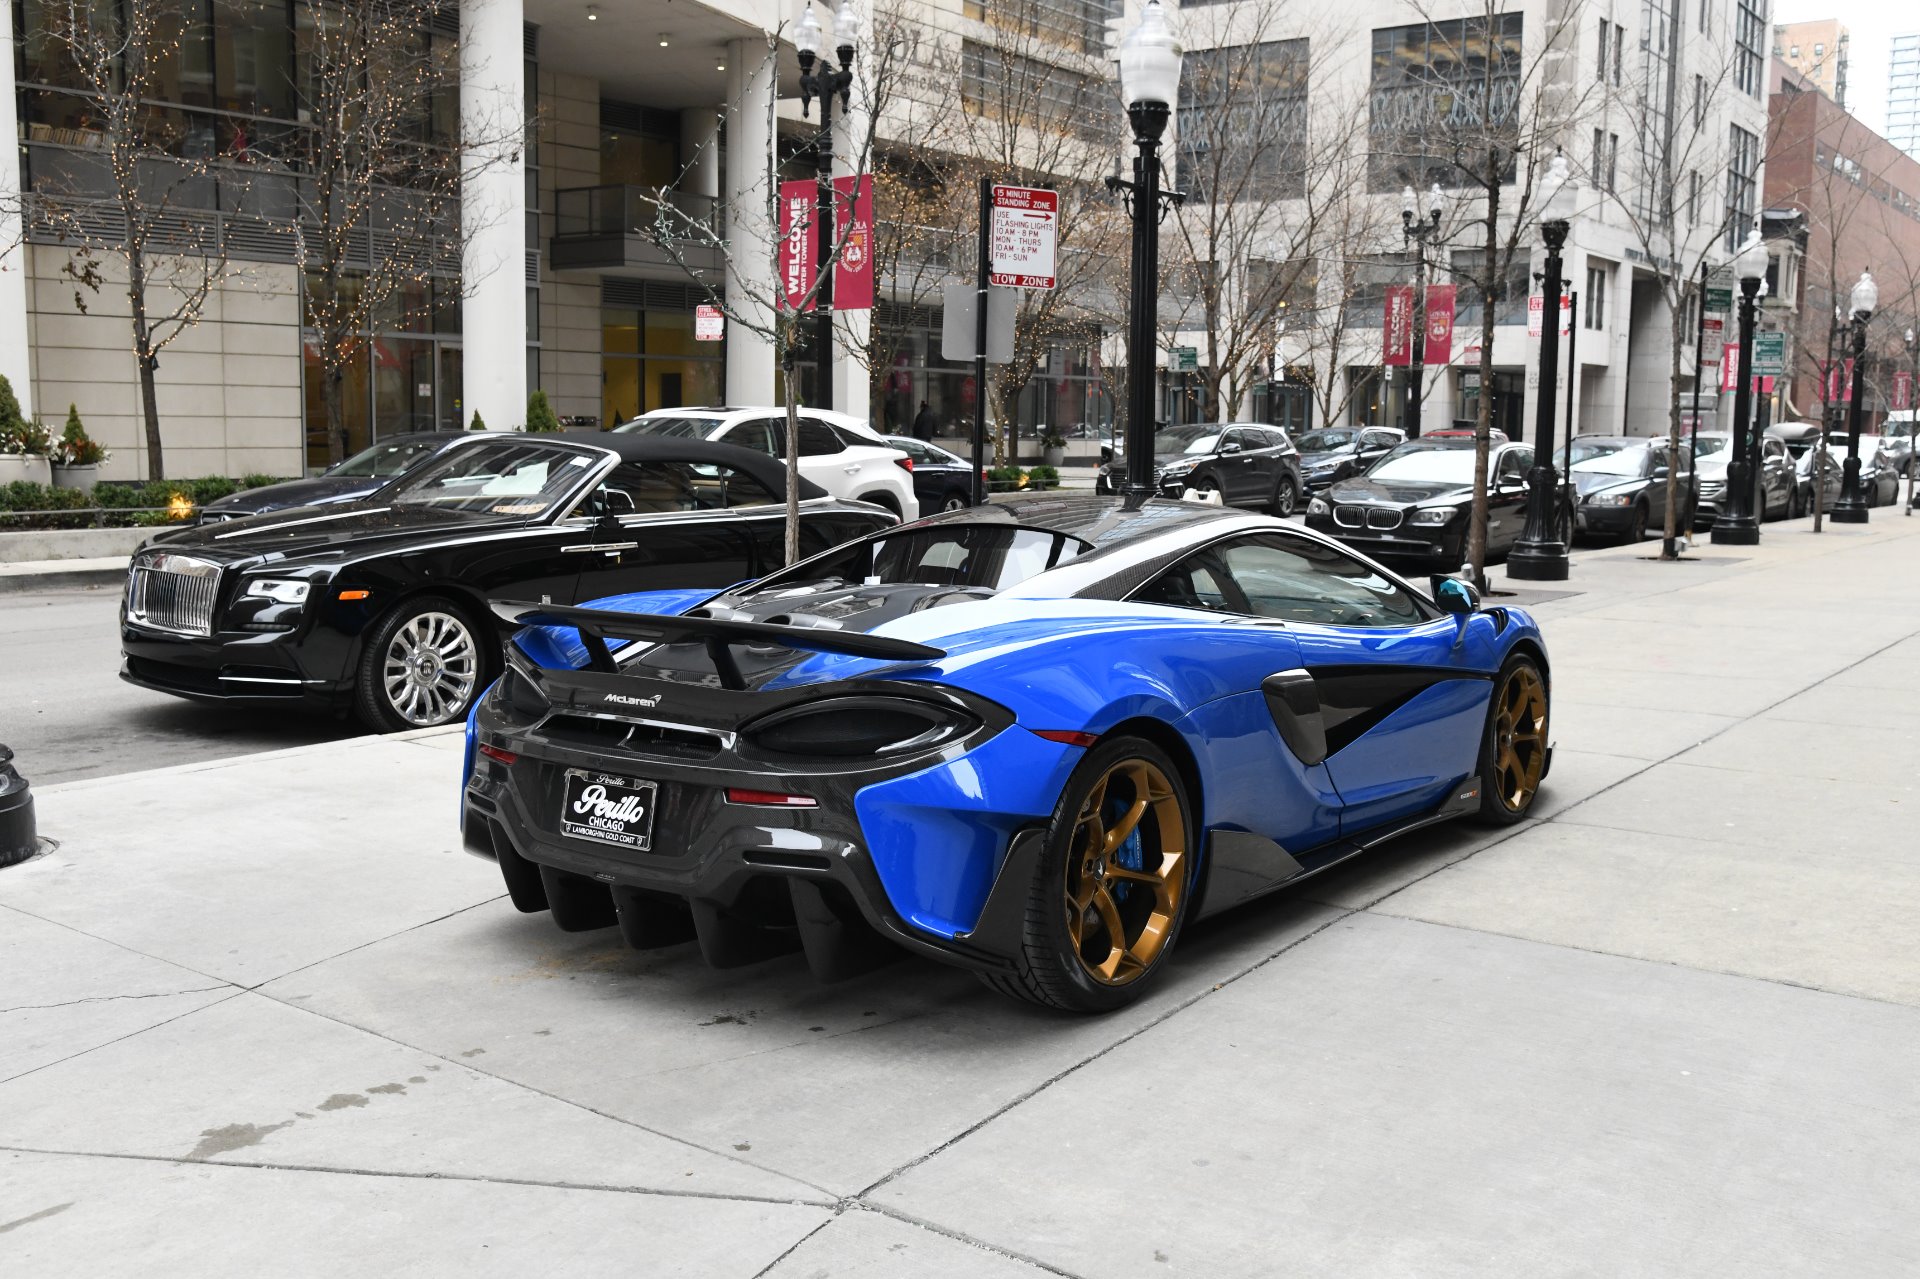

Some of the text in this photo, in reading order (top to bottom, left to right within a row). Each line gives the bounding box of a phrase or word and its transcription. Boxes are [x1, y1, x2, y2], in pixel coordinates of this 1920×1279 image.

[1006, 190, 1031, 200] MINUTE
[997, 198, 1051, 210] STANDING ZONE
[996, 211, 1010, 219] USE
[996, 220, 1053, 231] FLASHING LIGHTS
[1029, 230, 1039, 238] PM
[788, 198, 801, 295] WELCOME
[996, 236, 1011, 244] MON
[1019, 238, 1042, 246] THURS
[1021, 246, 1026, 254] 6
[995, 274, 1050, 287] TOW ZONE
[1390, 296, 1400, 355] WELCOME
[604, 694, 656, 708] McLaren
[596, 774, 626, 786] Perillo
[574, 784, 644, 824] Perillo
[588, 816, 625, 832] CHICAGO
[572, 826, 636, 844] LAMBORGHINI GOLD COAST
